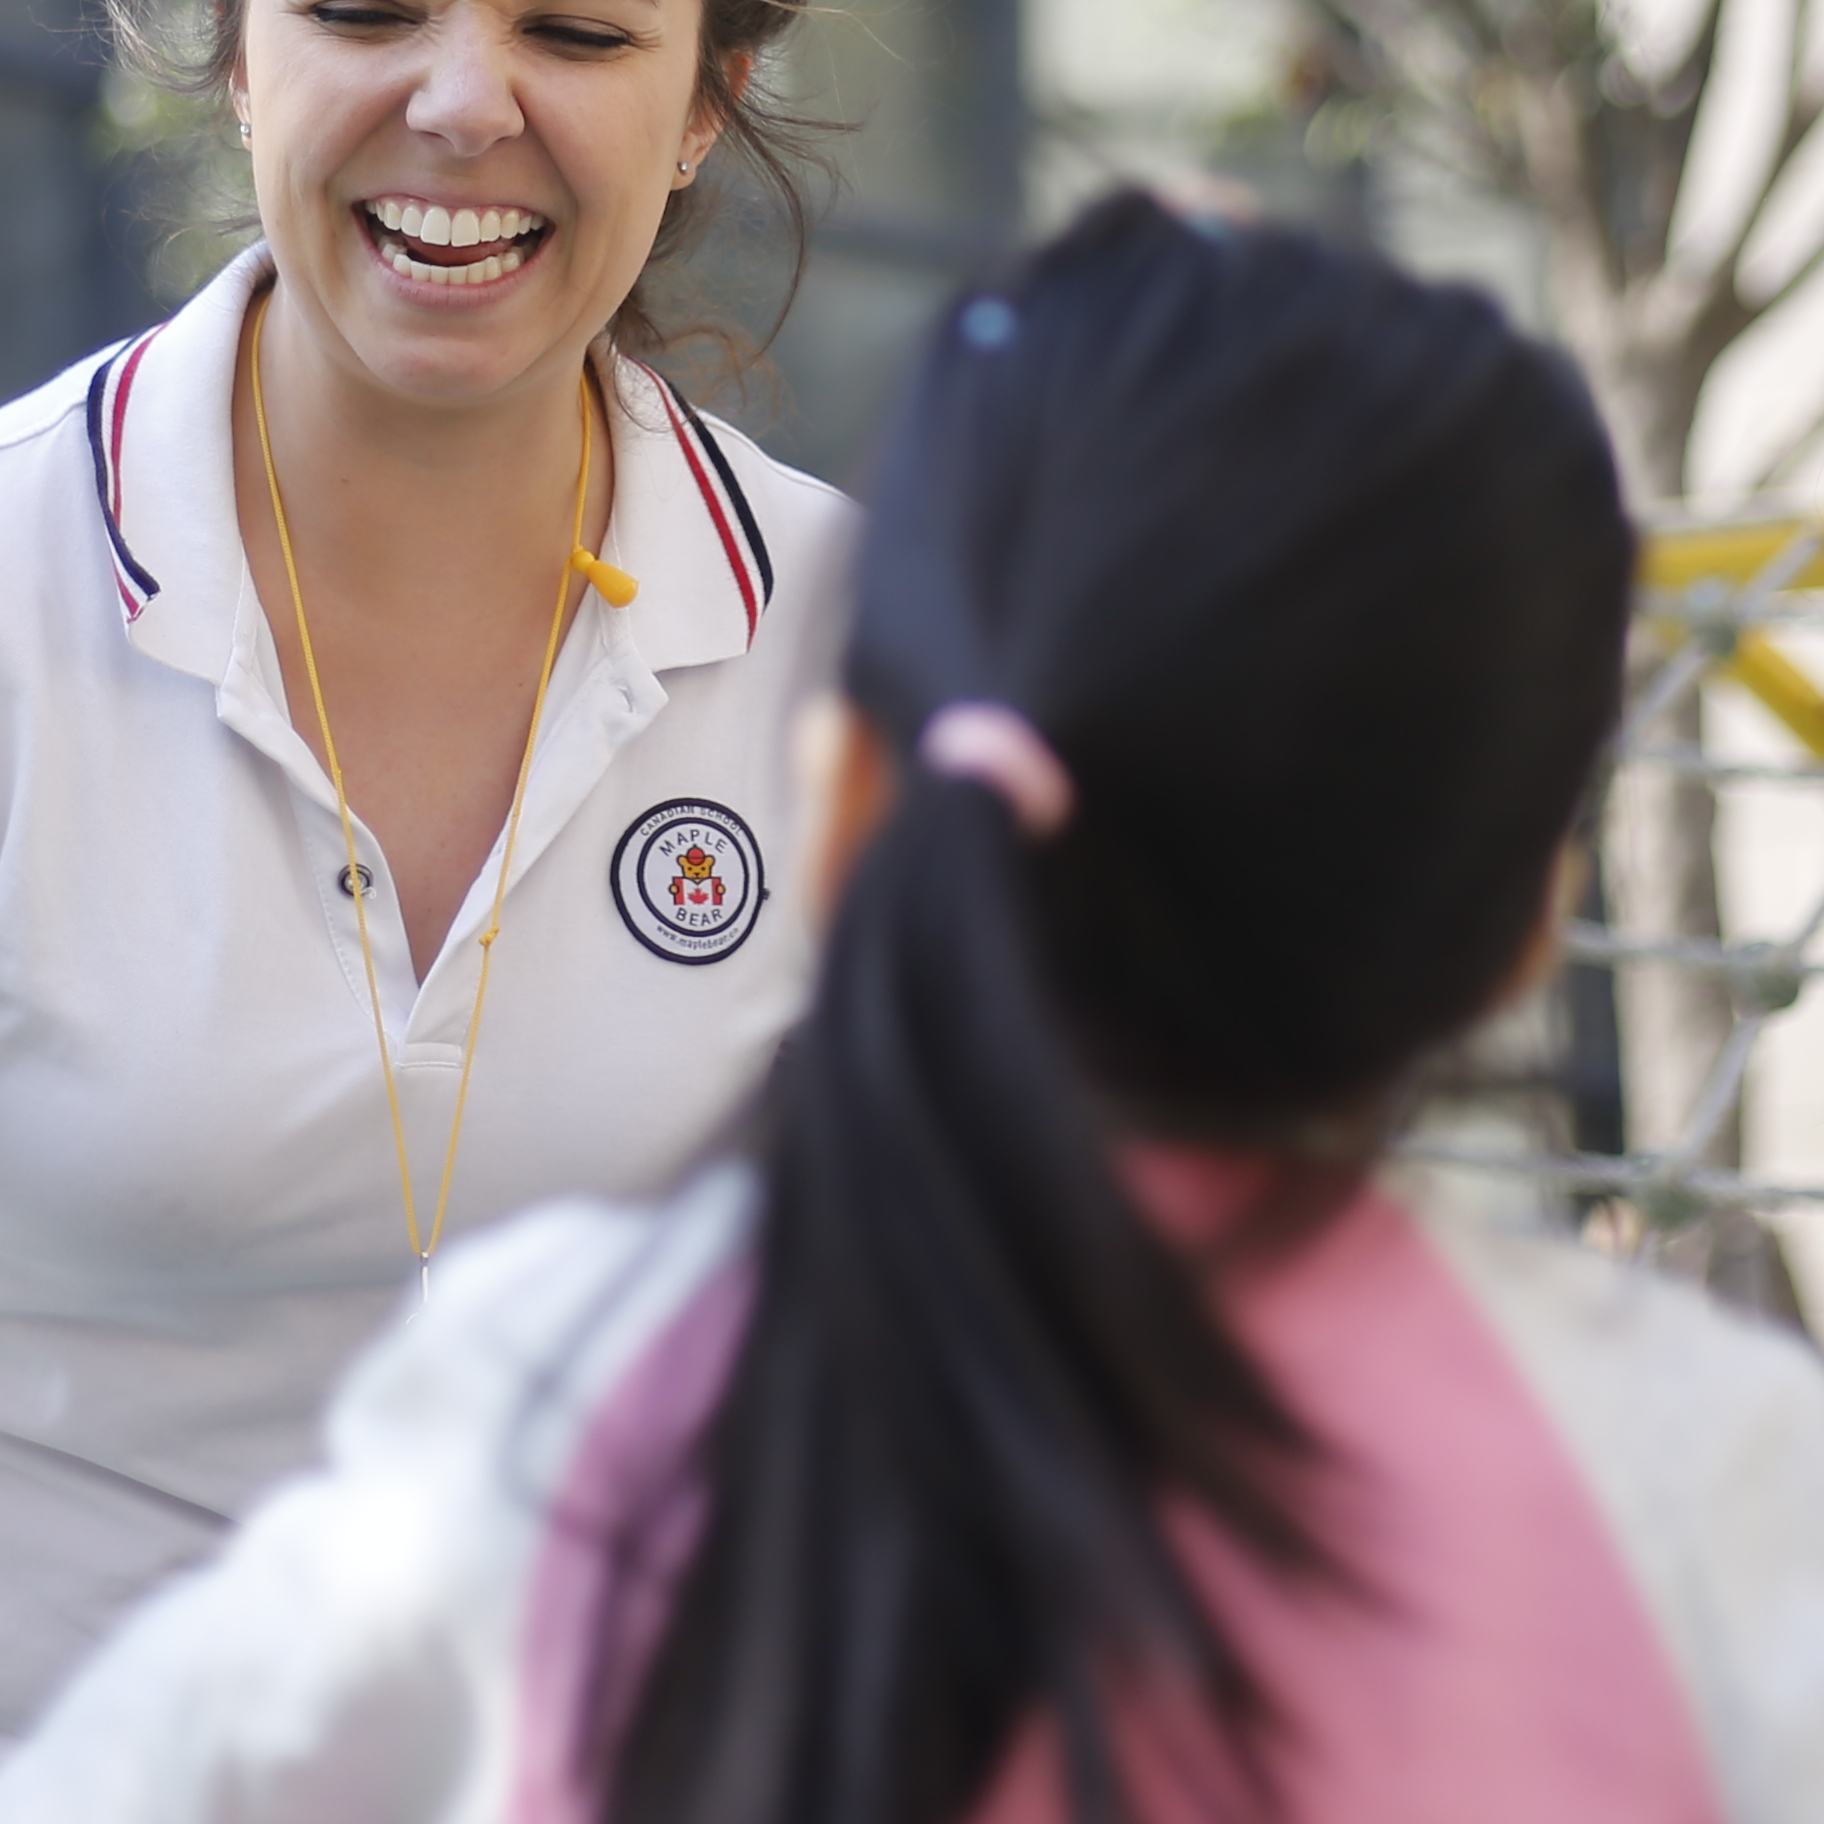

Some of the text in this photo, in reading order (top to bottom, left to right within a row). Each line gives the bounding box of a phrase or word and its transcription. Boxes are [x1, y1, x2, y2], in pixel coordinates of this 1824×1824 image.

[640, 805, 743, 837] CANADIAN SCHOOL
[659, 829, 728, 857] MAPLE
[675, 907, 723, 927] BEAR
